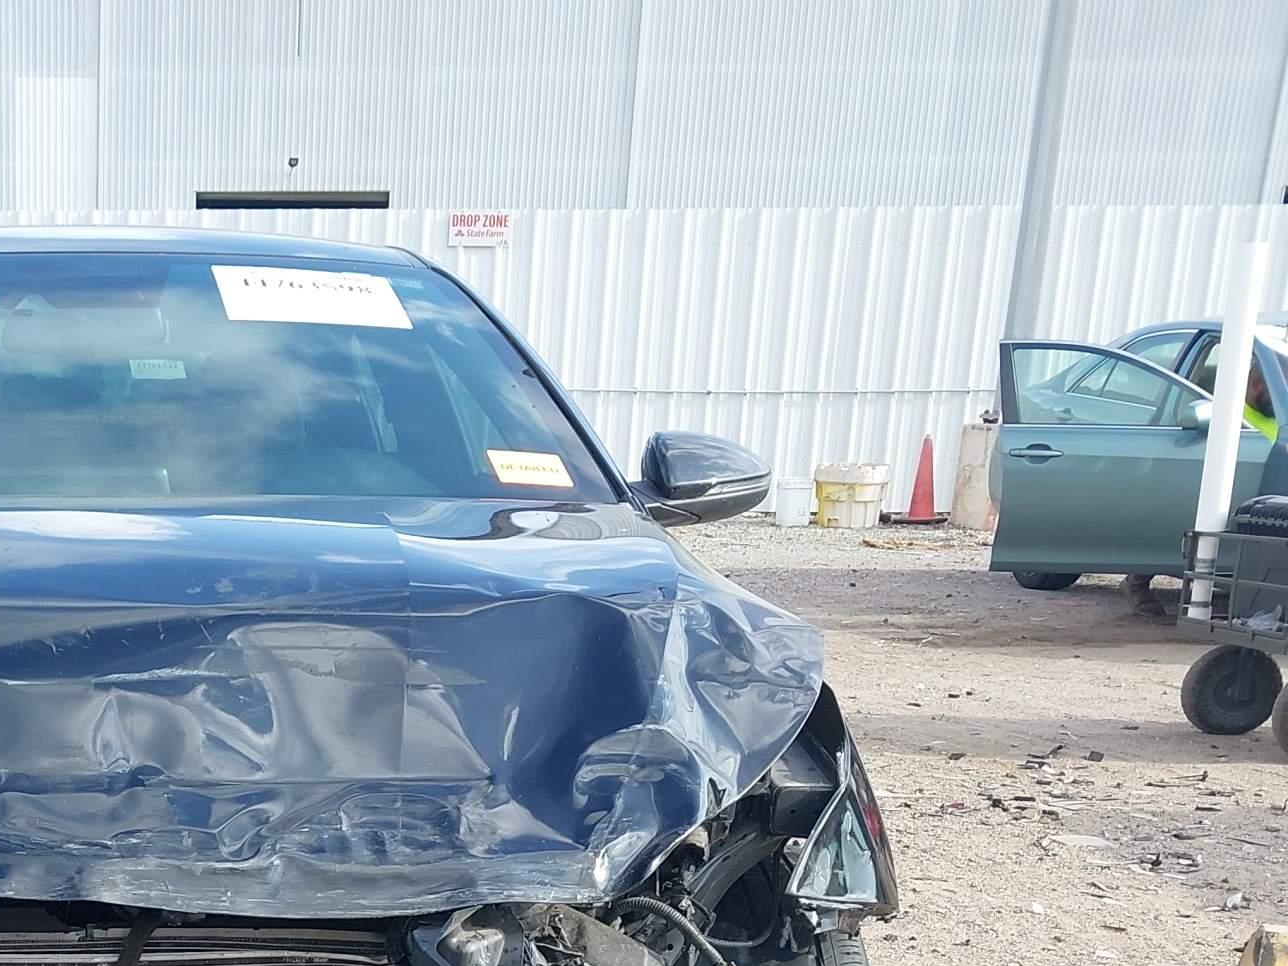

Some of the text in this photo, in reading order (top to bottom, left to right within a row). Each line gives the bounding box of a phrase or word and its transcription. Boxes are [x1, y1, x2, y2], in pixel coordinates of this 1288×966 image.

[452, 214, 510, 228] DROP ZONE
[466, 229, 484, 238] State
